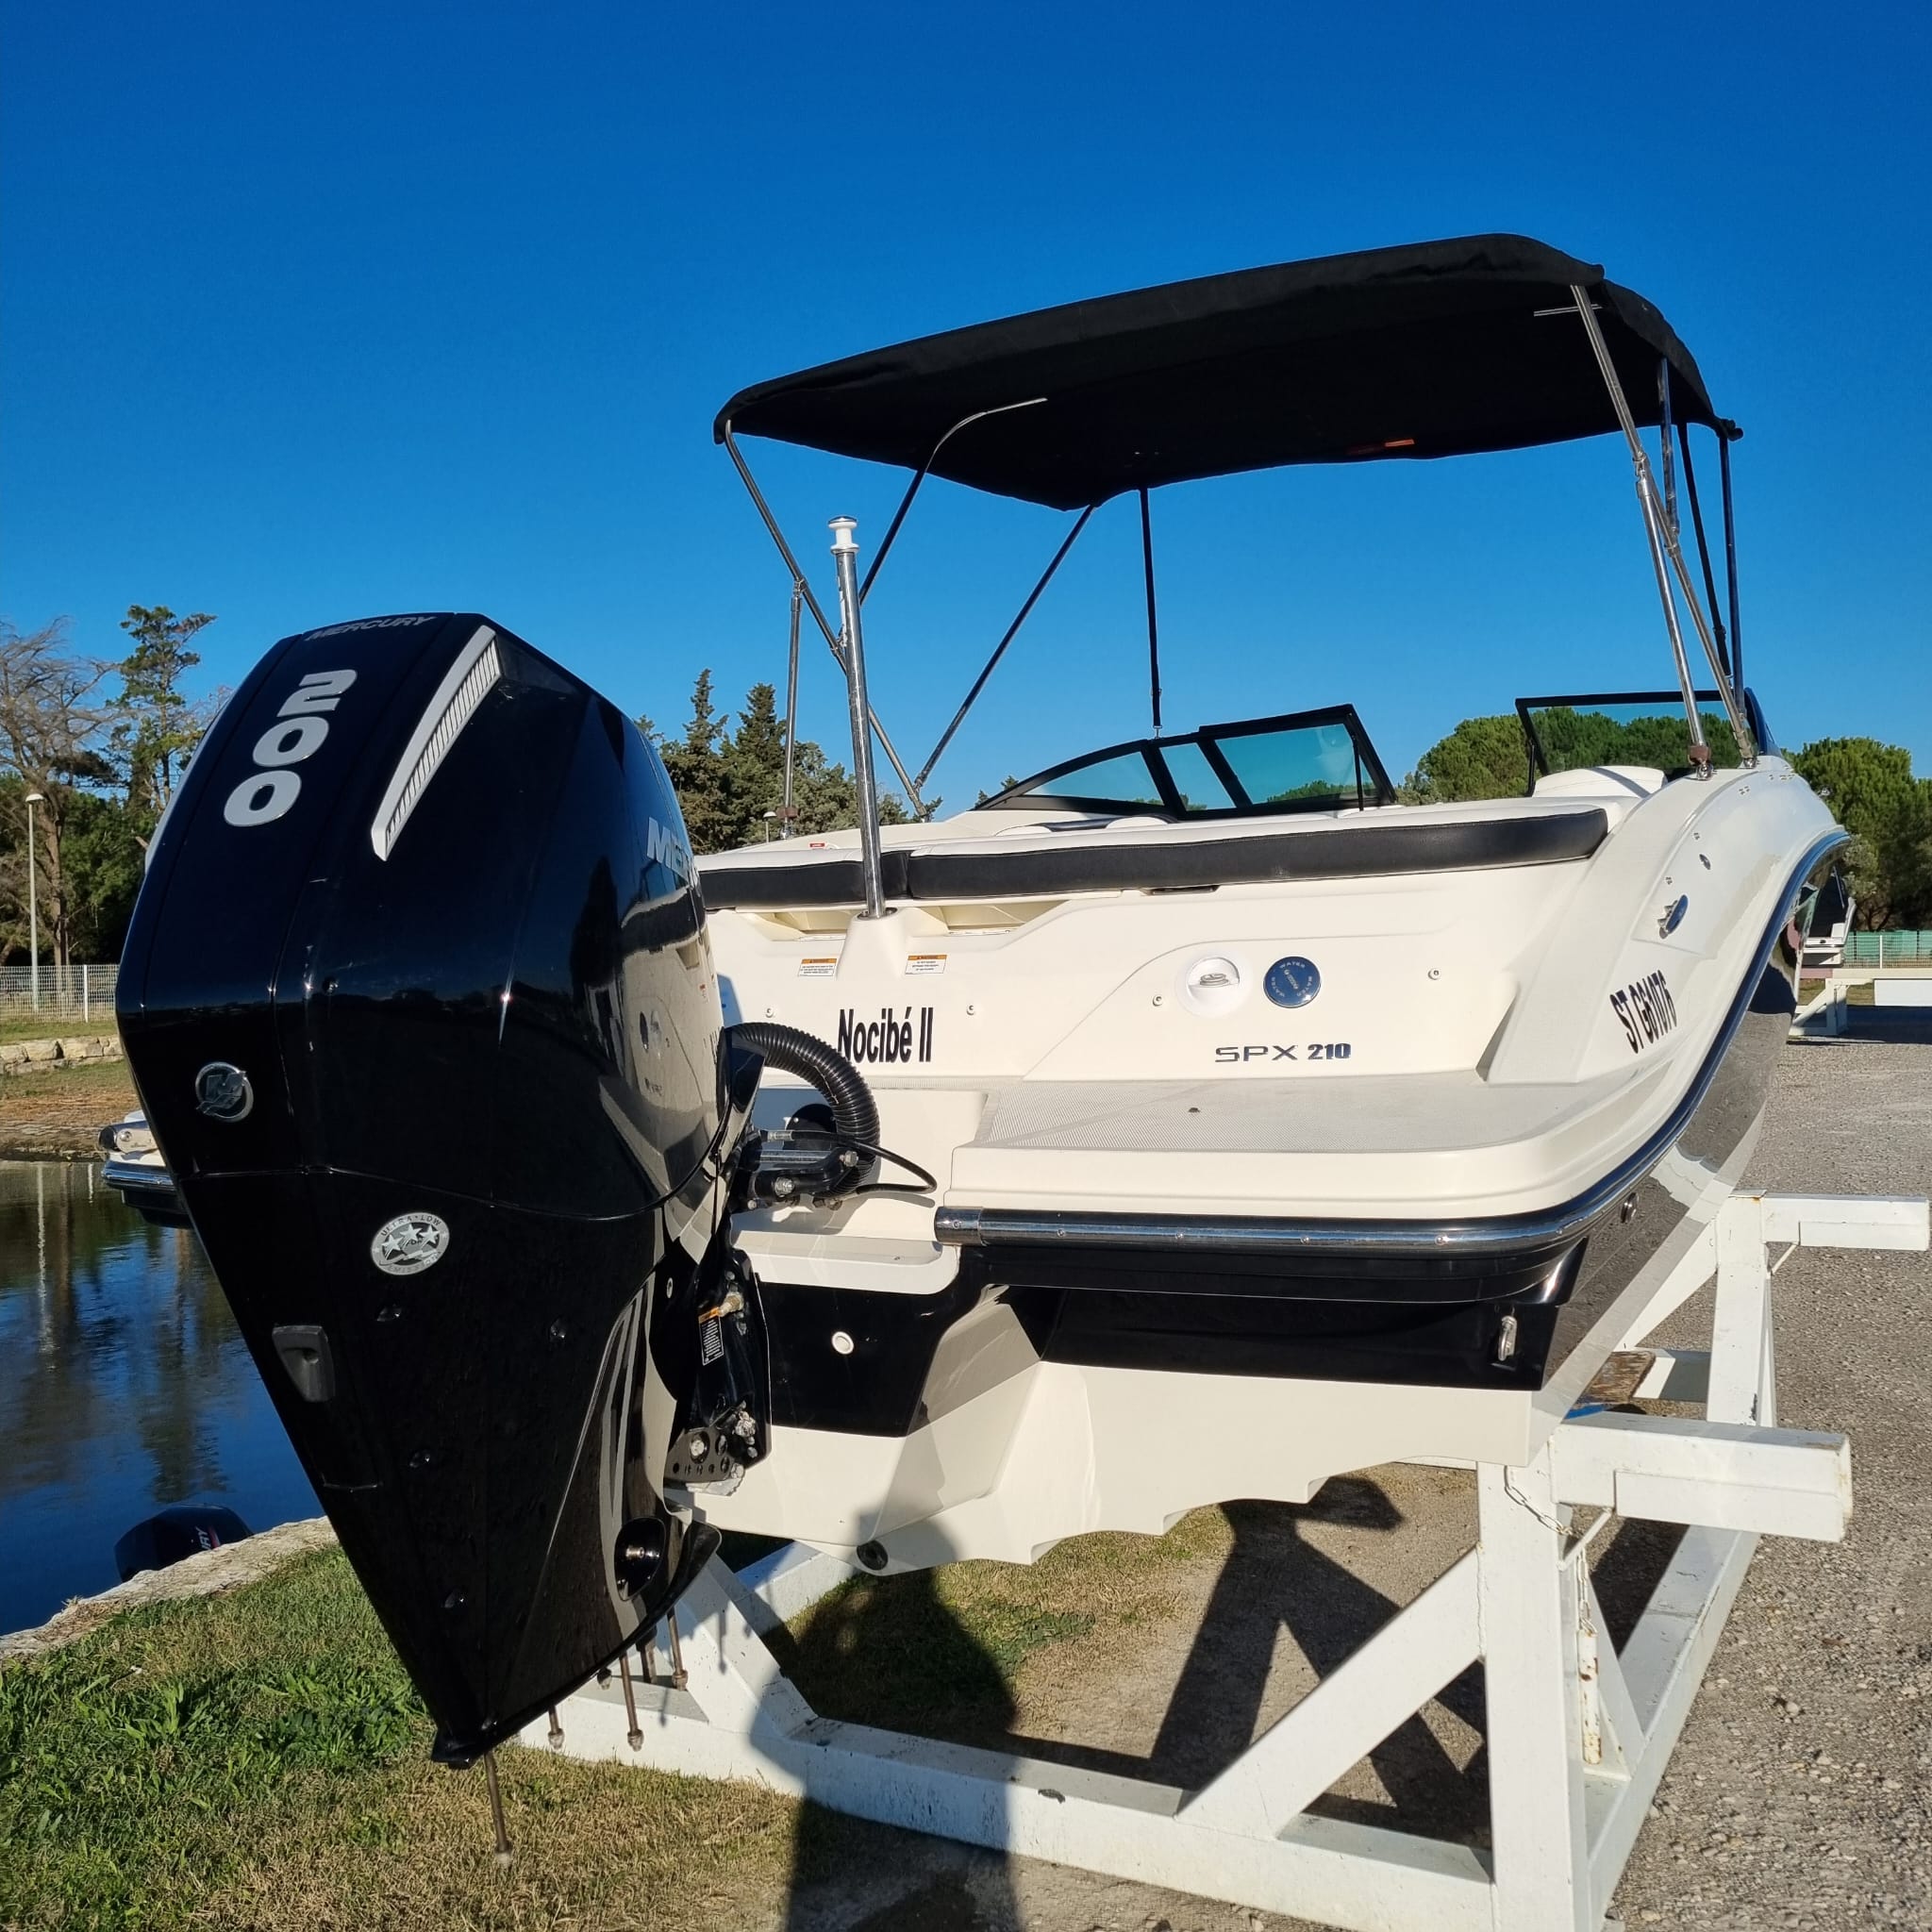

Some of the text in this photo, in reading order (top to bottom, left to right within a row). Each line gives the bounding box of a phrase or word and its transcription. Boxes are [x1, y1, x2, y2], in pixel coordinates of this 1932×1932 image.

[304, 616, 438, 641] MERCURY
[223, 669, 358, 827] 200
[837, 1006, 913, 1063] Nocibé
[1609, 969, 1677, 1054] ST G61076
[1215, 1042, 1351, 1063] SPX 210
